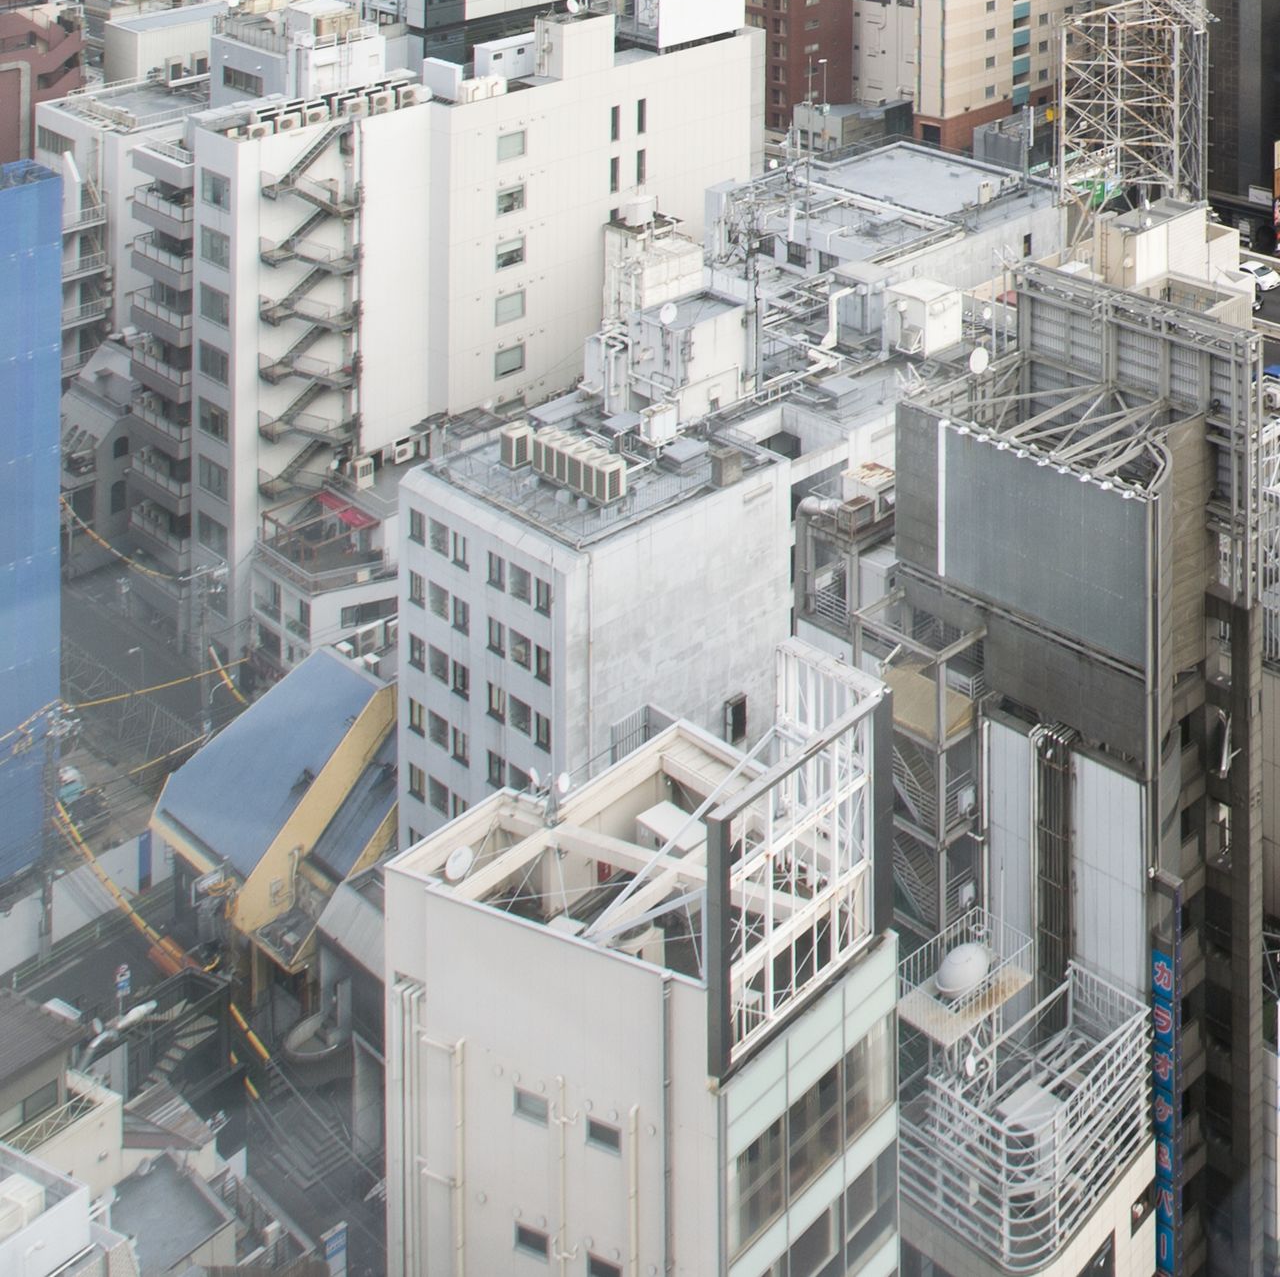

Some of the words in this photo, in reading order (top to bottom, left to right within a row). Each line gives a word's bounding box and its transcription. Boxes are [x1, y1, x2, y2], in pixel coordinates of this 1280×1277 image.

[1153, 958, 1174, 1277] カラオケ&パー
